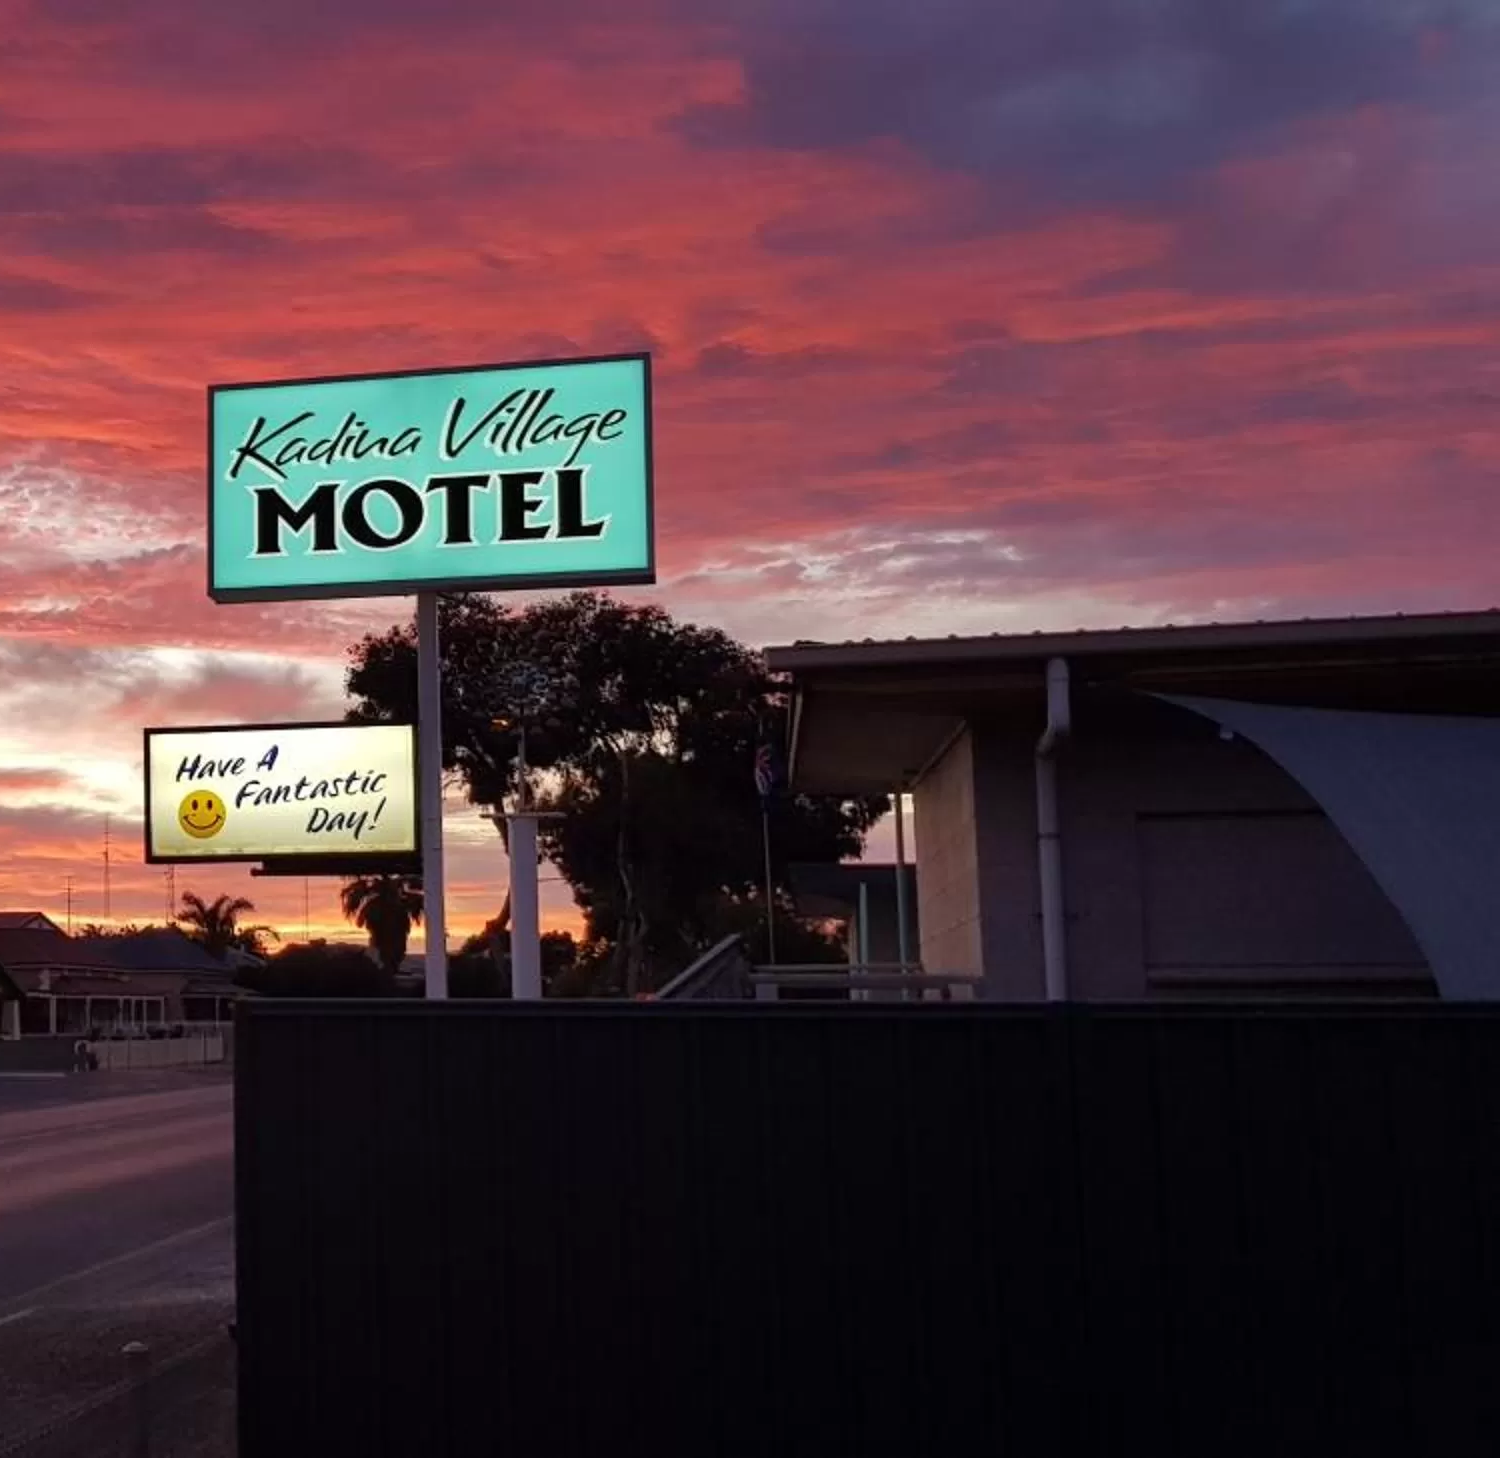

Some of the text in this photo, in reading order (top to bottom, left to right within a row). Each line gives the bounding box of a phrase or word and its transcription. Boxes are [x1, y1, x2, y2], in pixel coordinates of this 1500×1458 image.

[230, 388, 627, 479] Kadina Village
[255, 468, 607, 555] MOTEL
[176, 744, 279, 782] Have A
[235, 770, 387, 809] Fantastic
[306, 797, 387, 840] Day!
